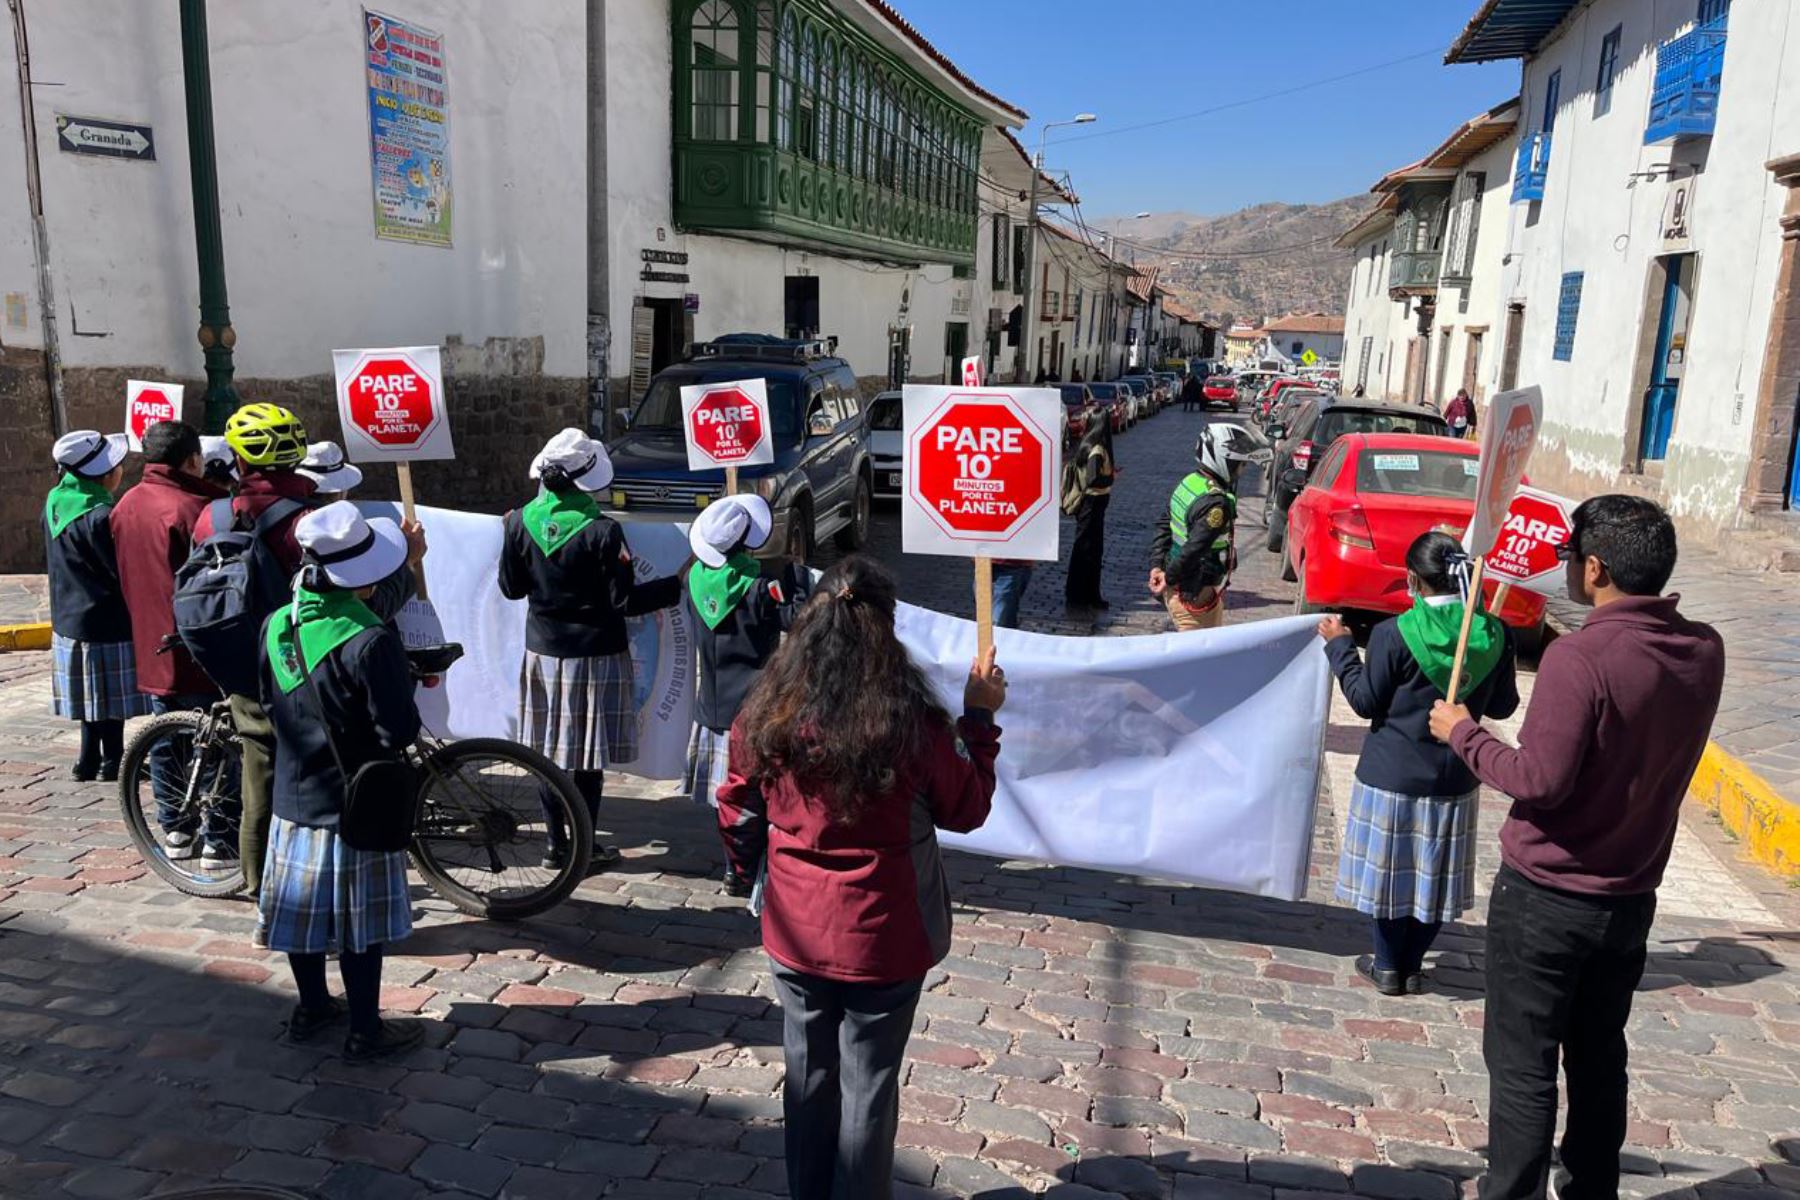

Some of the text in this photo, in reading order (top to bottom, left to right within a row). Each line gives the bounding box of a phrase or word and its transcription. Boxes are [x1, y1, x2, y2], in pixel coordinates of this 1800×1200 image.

[80, 128, 132, 146] Granada
[360, 374, 417, 393] PARE
[134, 401, 171, 418] PARE
[697, 404, 755, 426] PARE
[368, 423, 420, 434] PLANETA
[936, 425, 1023, 454] PARE
[713, 447, 746, 457] PLANETA
[956, 481, 1001, 491] MINUTOS
[962, 491, 995, 500] POR EL
[939, 500, 1018, 516] PLANETA
[1498, 549, 1529, 566] POR EL
[1489, 557, 1530, 577] PLANETA
